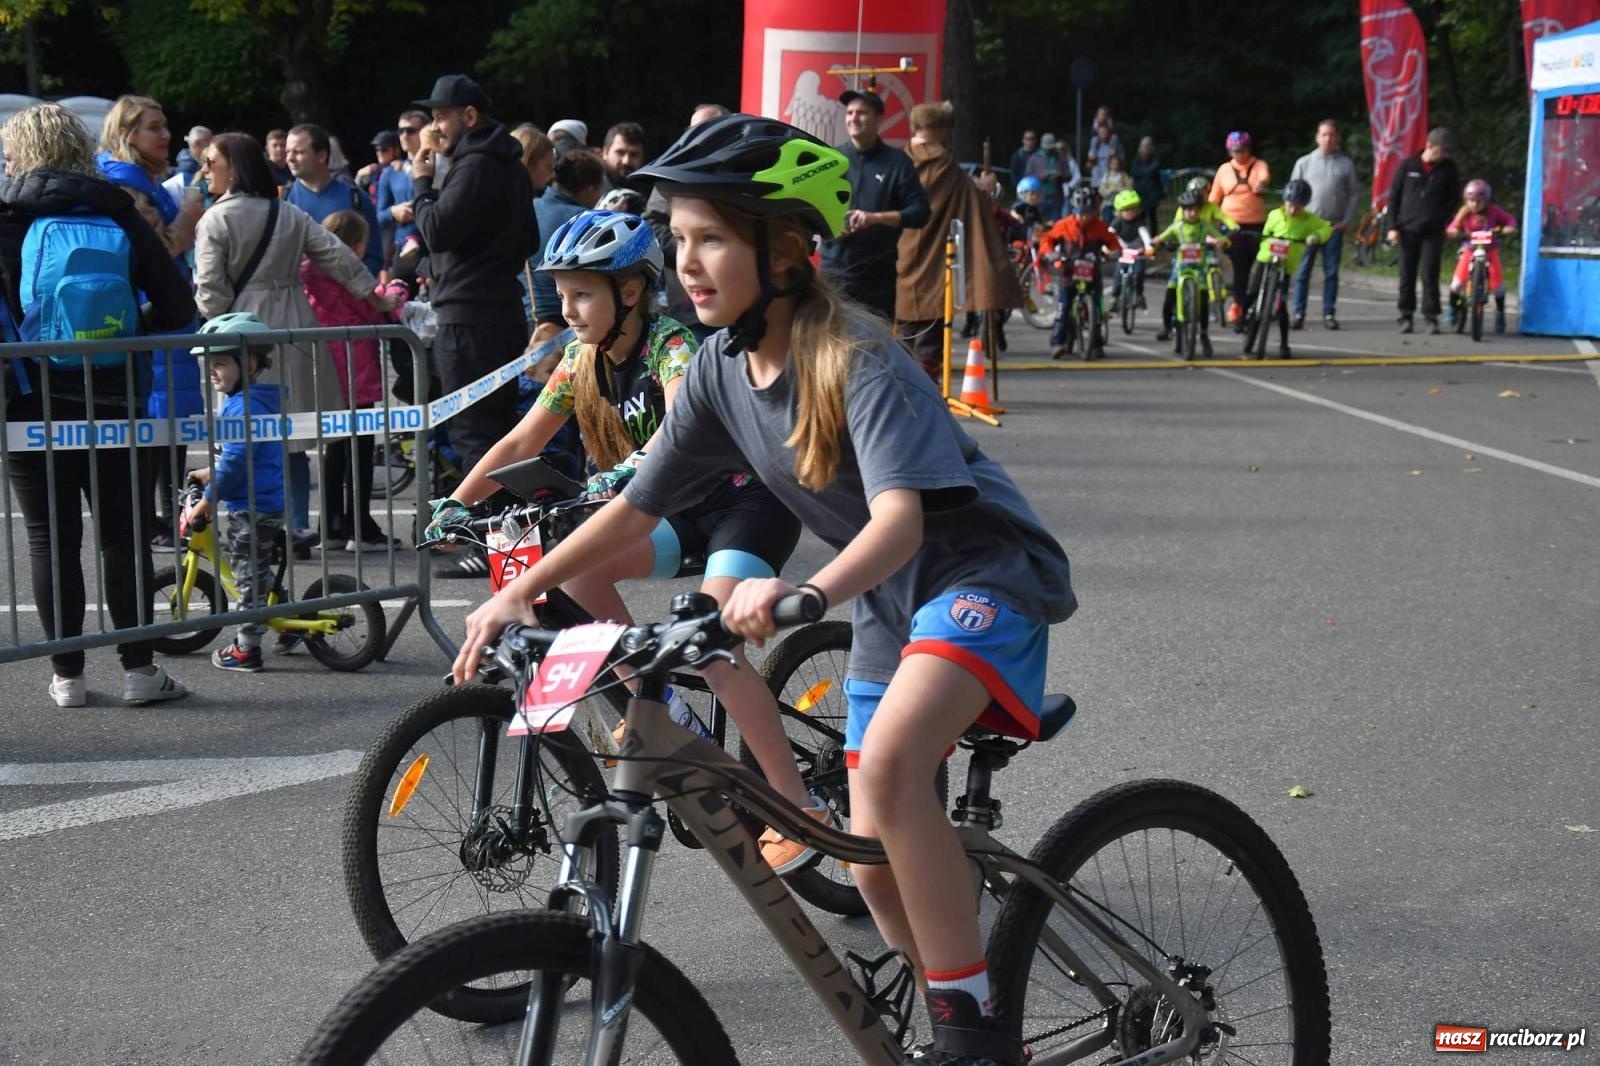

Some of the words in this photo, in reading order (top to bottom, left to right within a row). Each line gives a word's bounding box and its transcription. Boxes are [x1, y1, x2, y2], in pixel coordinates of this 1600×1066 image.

[792, 159, 840, 185] ROCKRIDER
[618, 391, 647, 422] AY
[26, 422, 154, 448] SHIMANO
[180, 416, 293, 442] SHIMANO
[321, 408, 421, 438] SHIMANO
[966, 593, 990, 604] CUP
[541, 661, 586, 693] 94
